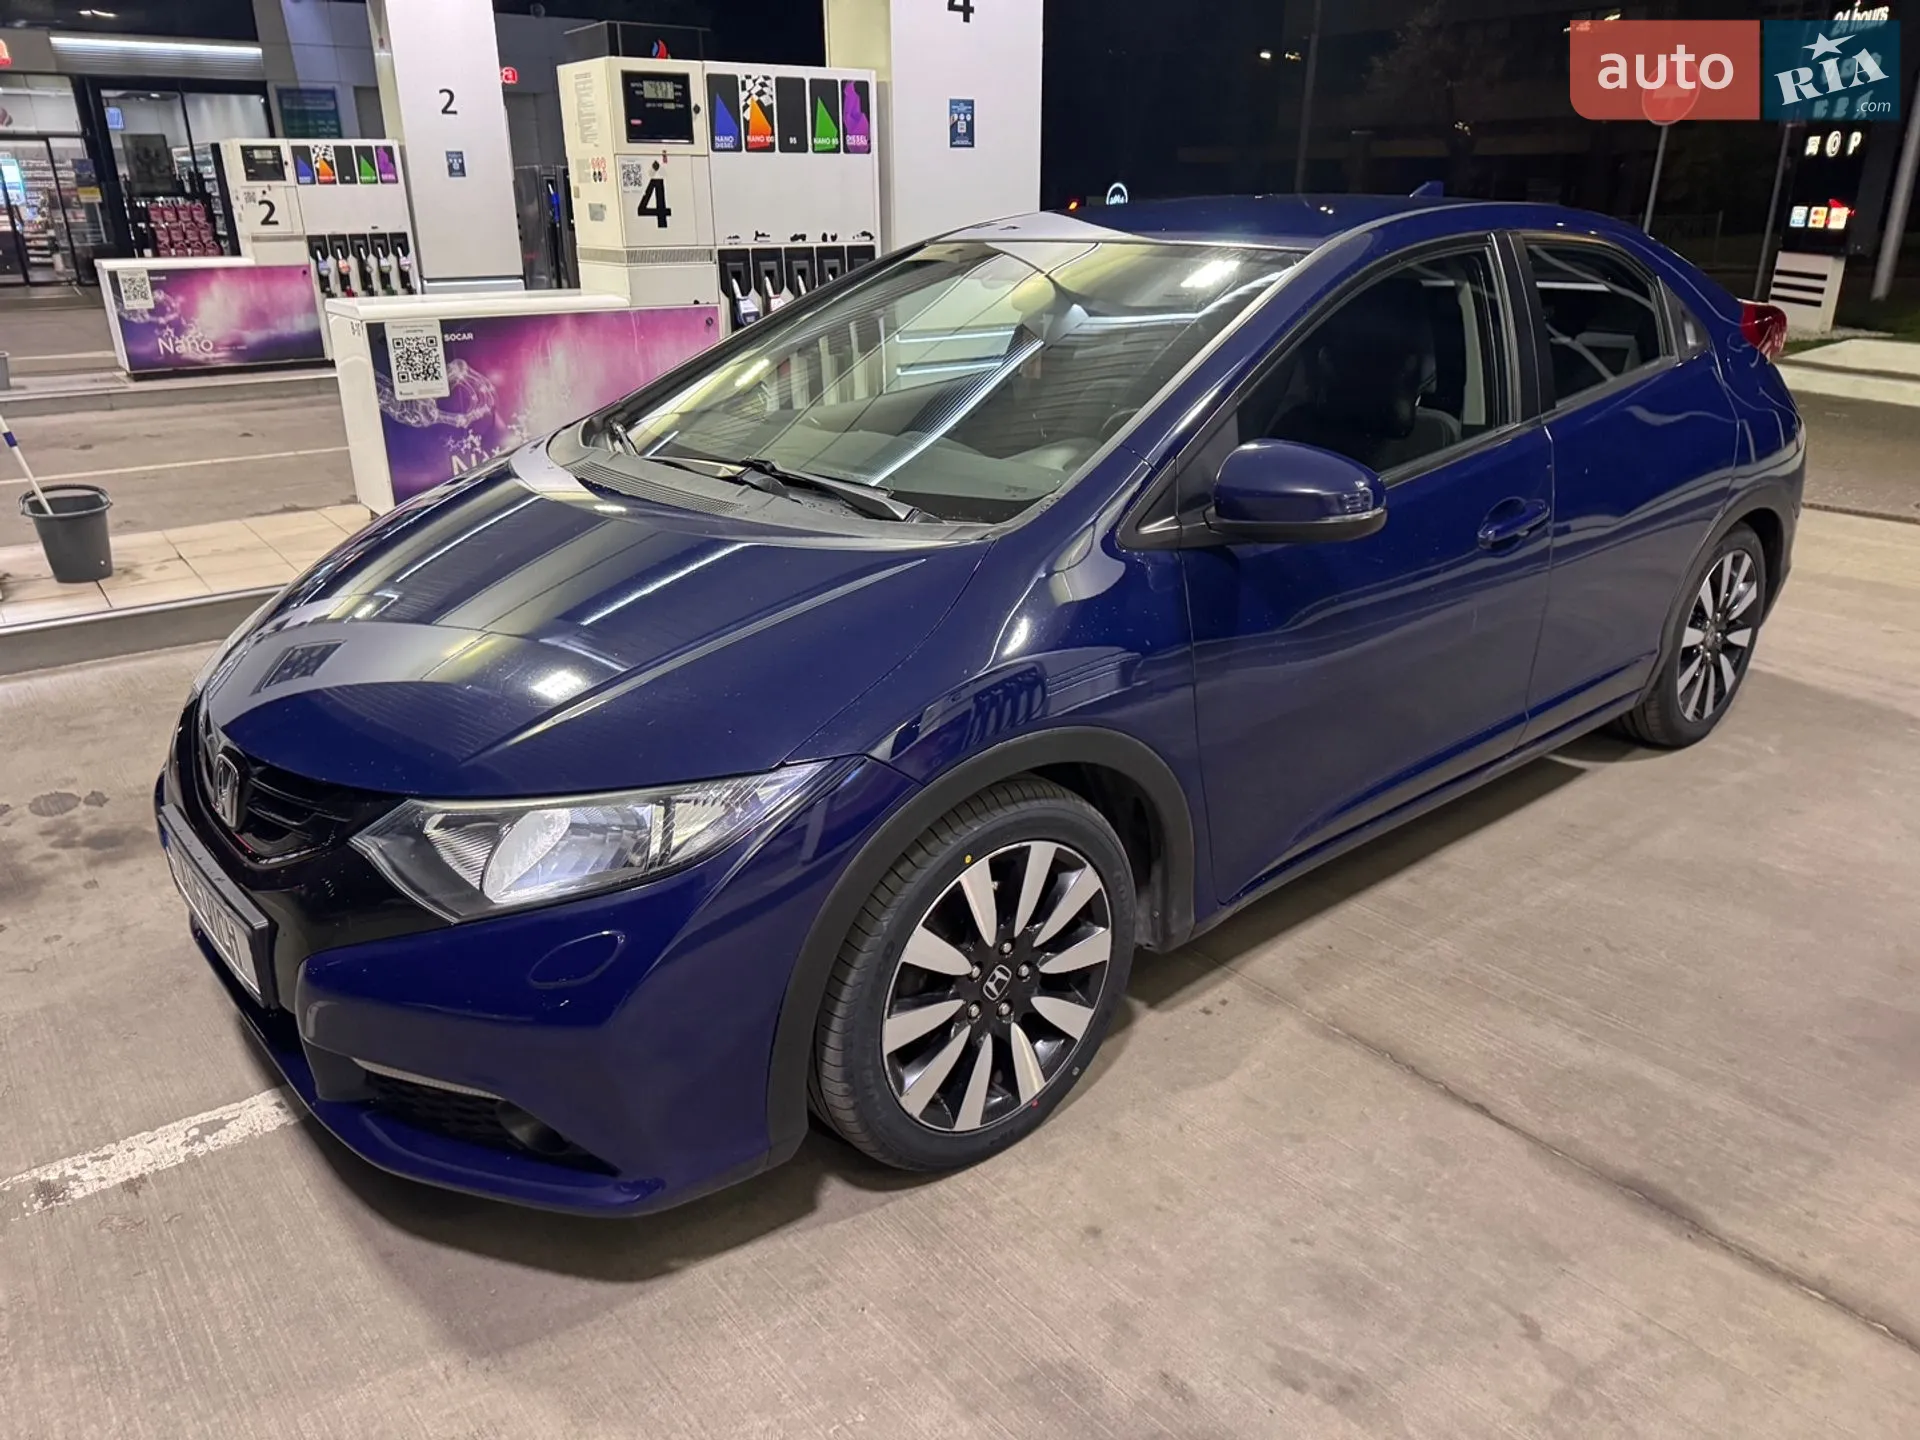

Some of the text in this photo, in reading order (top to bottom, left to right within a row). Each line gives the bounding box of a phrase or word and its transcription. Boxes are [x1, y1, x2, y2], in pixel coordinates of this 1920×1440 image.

[947, 0, 975, 23] 4
[439, 88, 458, 115] 2
[715, 135, 735, 143] NANO
[747, 135, 765, 143] NANO
[813, 137, 831, 145] NANO
[258, 199, 280, 226] 2
[637, 178, 672, 229] 4
[157, 336, 214, 356] Nano
[444, 332, 475, 342] SOCAR
